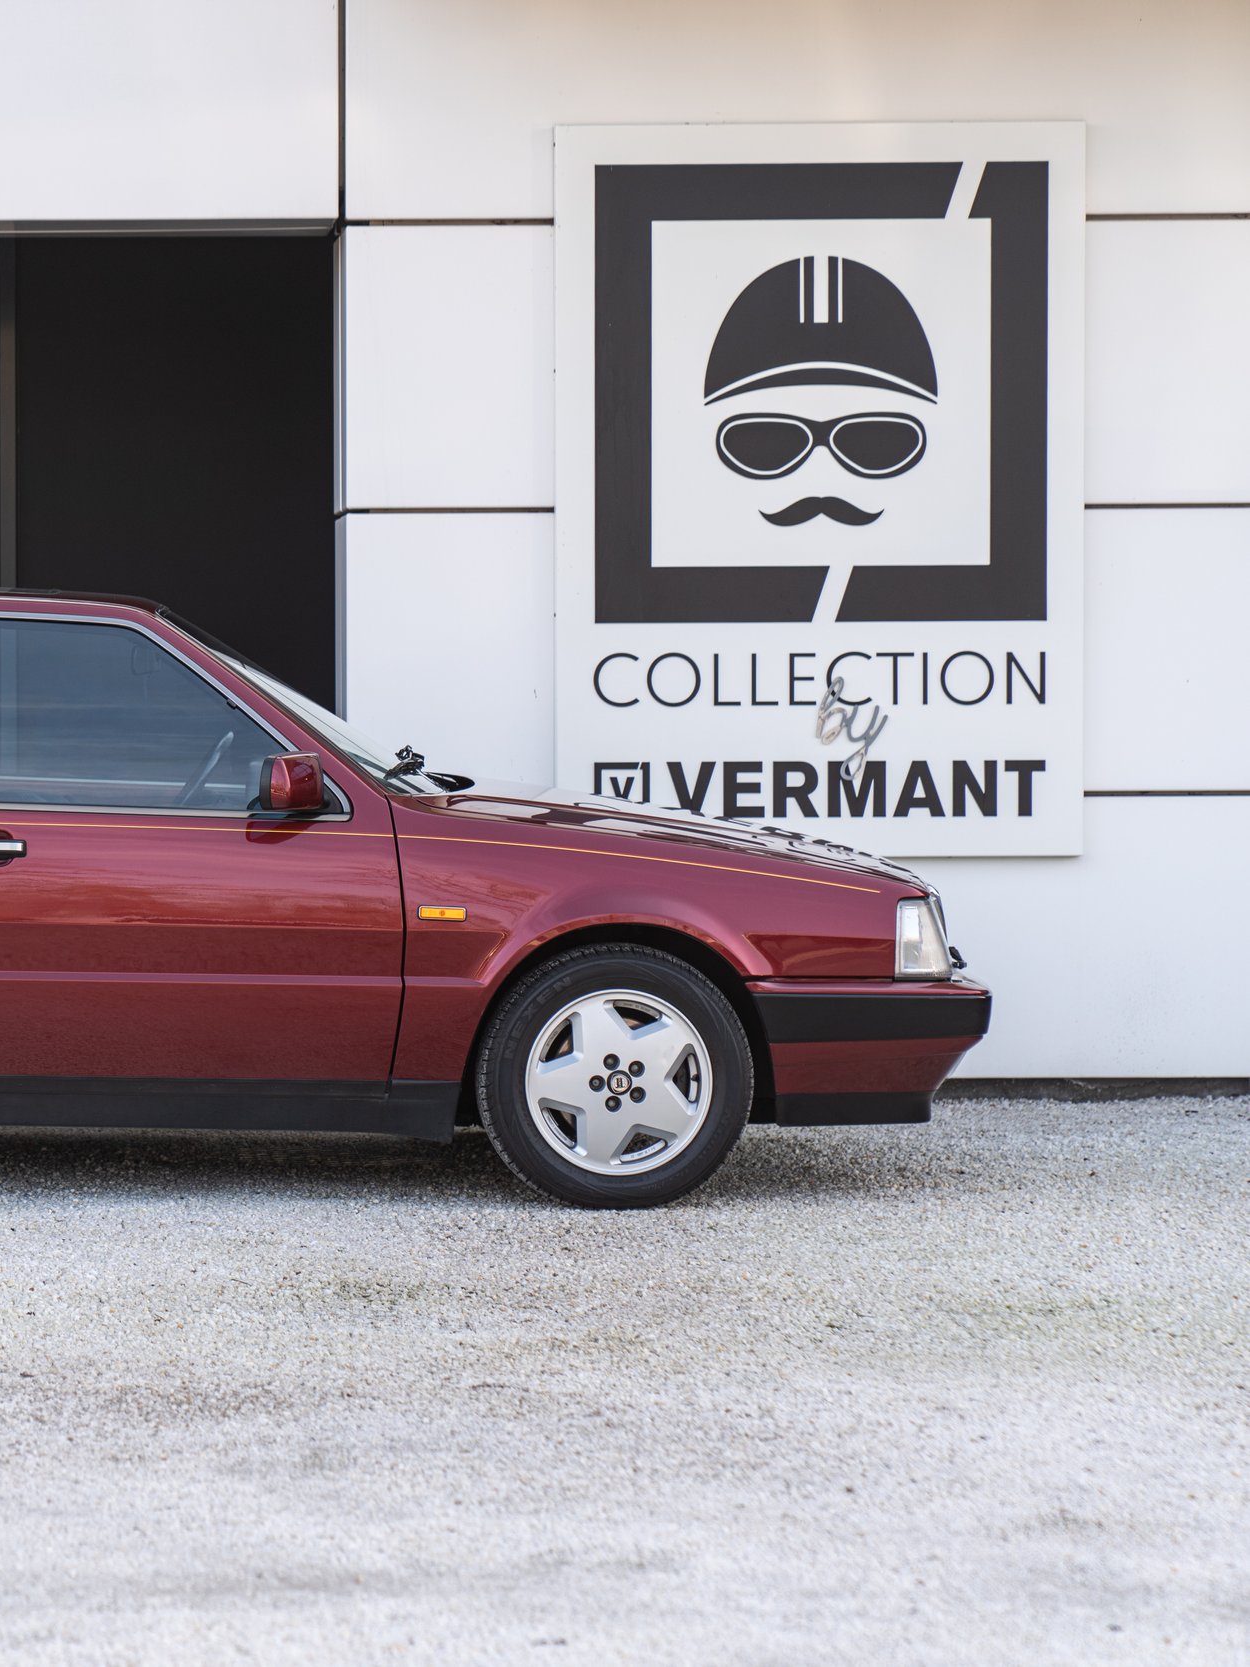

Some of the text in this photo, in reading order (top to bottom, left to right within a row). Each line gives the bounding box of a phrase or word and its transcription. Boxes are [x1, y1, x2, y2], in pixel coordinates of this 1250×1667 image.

[593, 651, 1046, 707] COLLECTION
[815, 676, 888, 781] by
[666, 760, 1046, 818] VERMANT
[504, 976, 572, 1059] NEXEN
